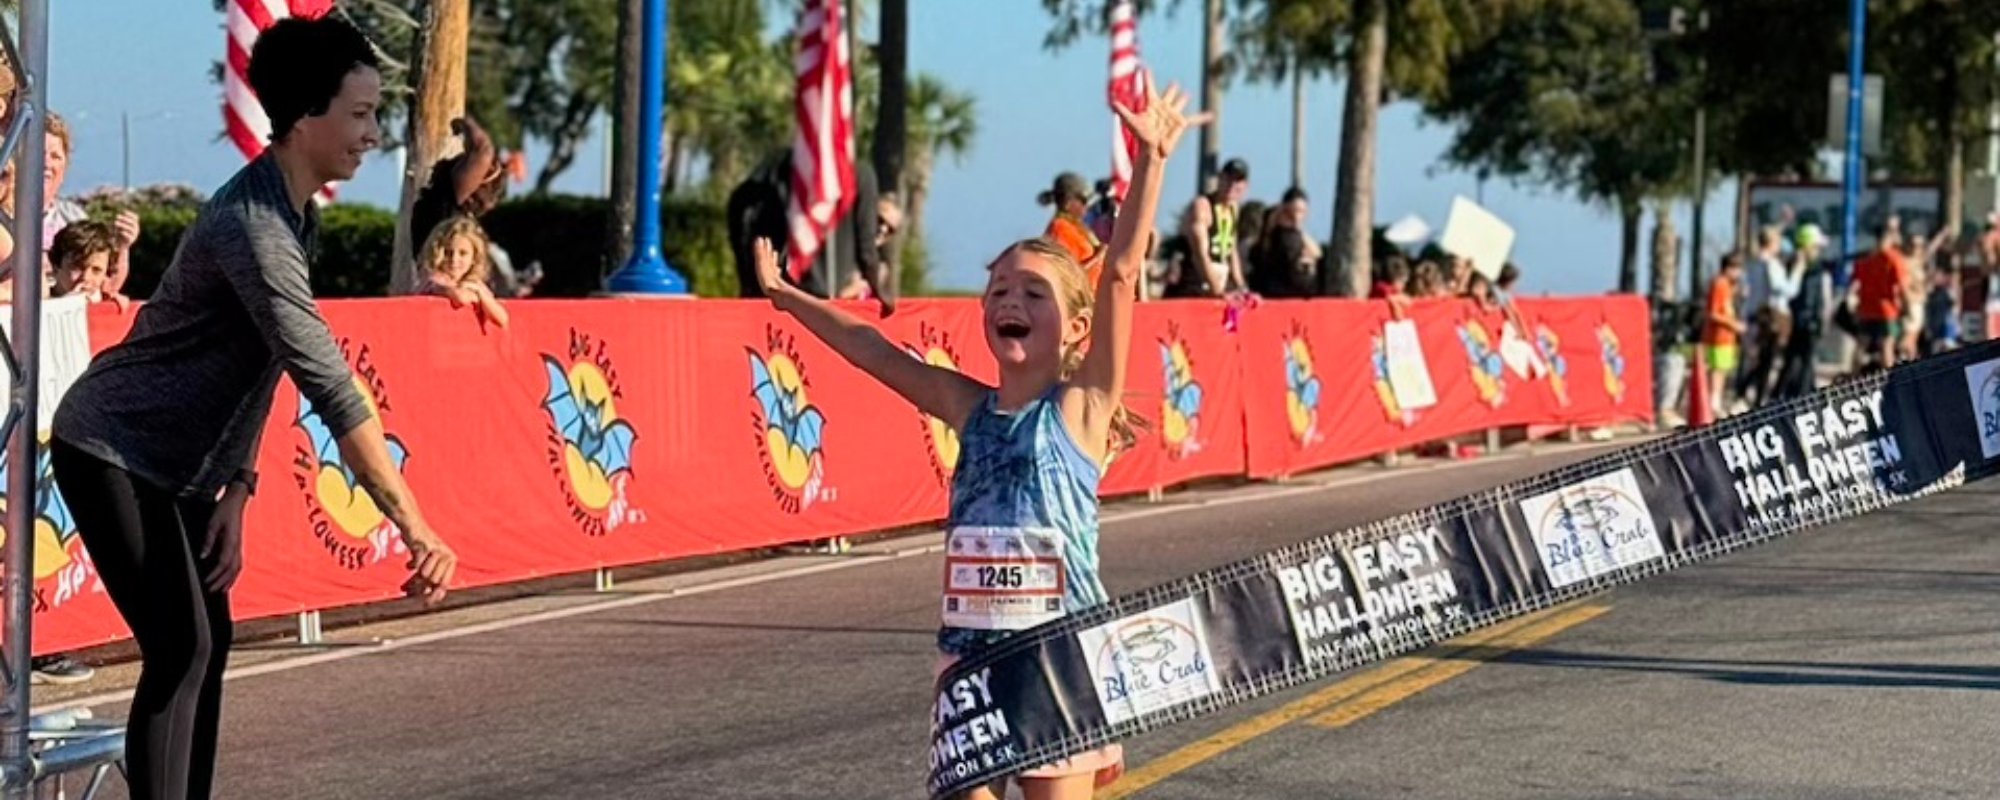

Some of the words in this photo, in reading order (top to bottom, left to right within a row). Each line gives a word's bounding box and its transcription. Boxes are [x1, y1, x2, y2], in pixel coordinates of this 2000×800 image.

[1717, 425, 1786, 473] BIG
[1795, 391, 1884, 451] EASY
[1735, 434, 1902, 509] HALLOWEEN
[1277, 555, 1344, 604] BIG
[1353, 526, 1439, 586] EASY
[1600, 518, 1649, 550] Crab
[977, 566, 1022, 588] 1245
[1296, 569, 1458, 639] HALLOWEEN
[1159, 651, 1206, 684] Crab
[929, 707, 1011, 769] OWEEN
[931, 759, 980, 793] ATHON
